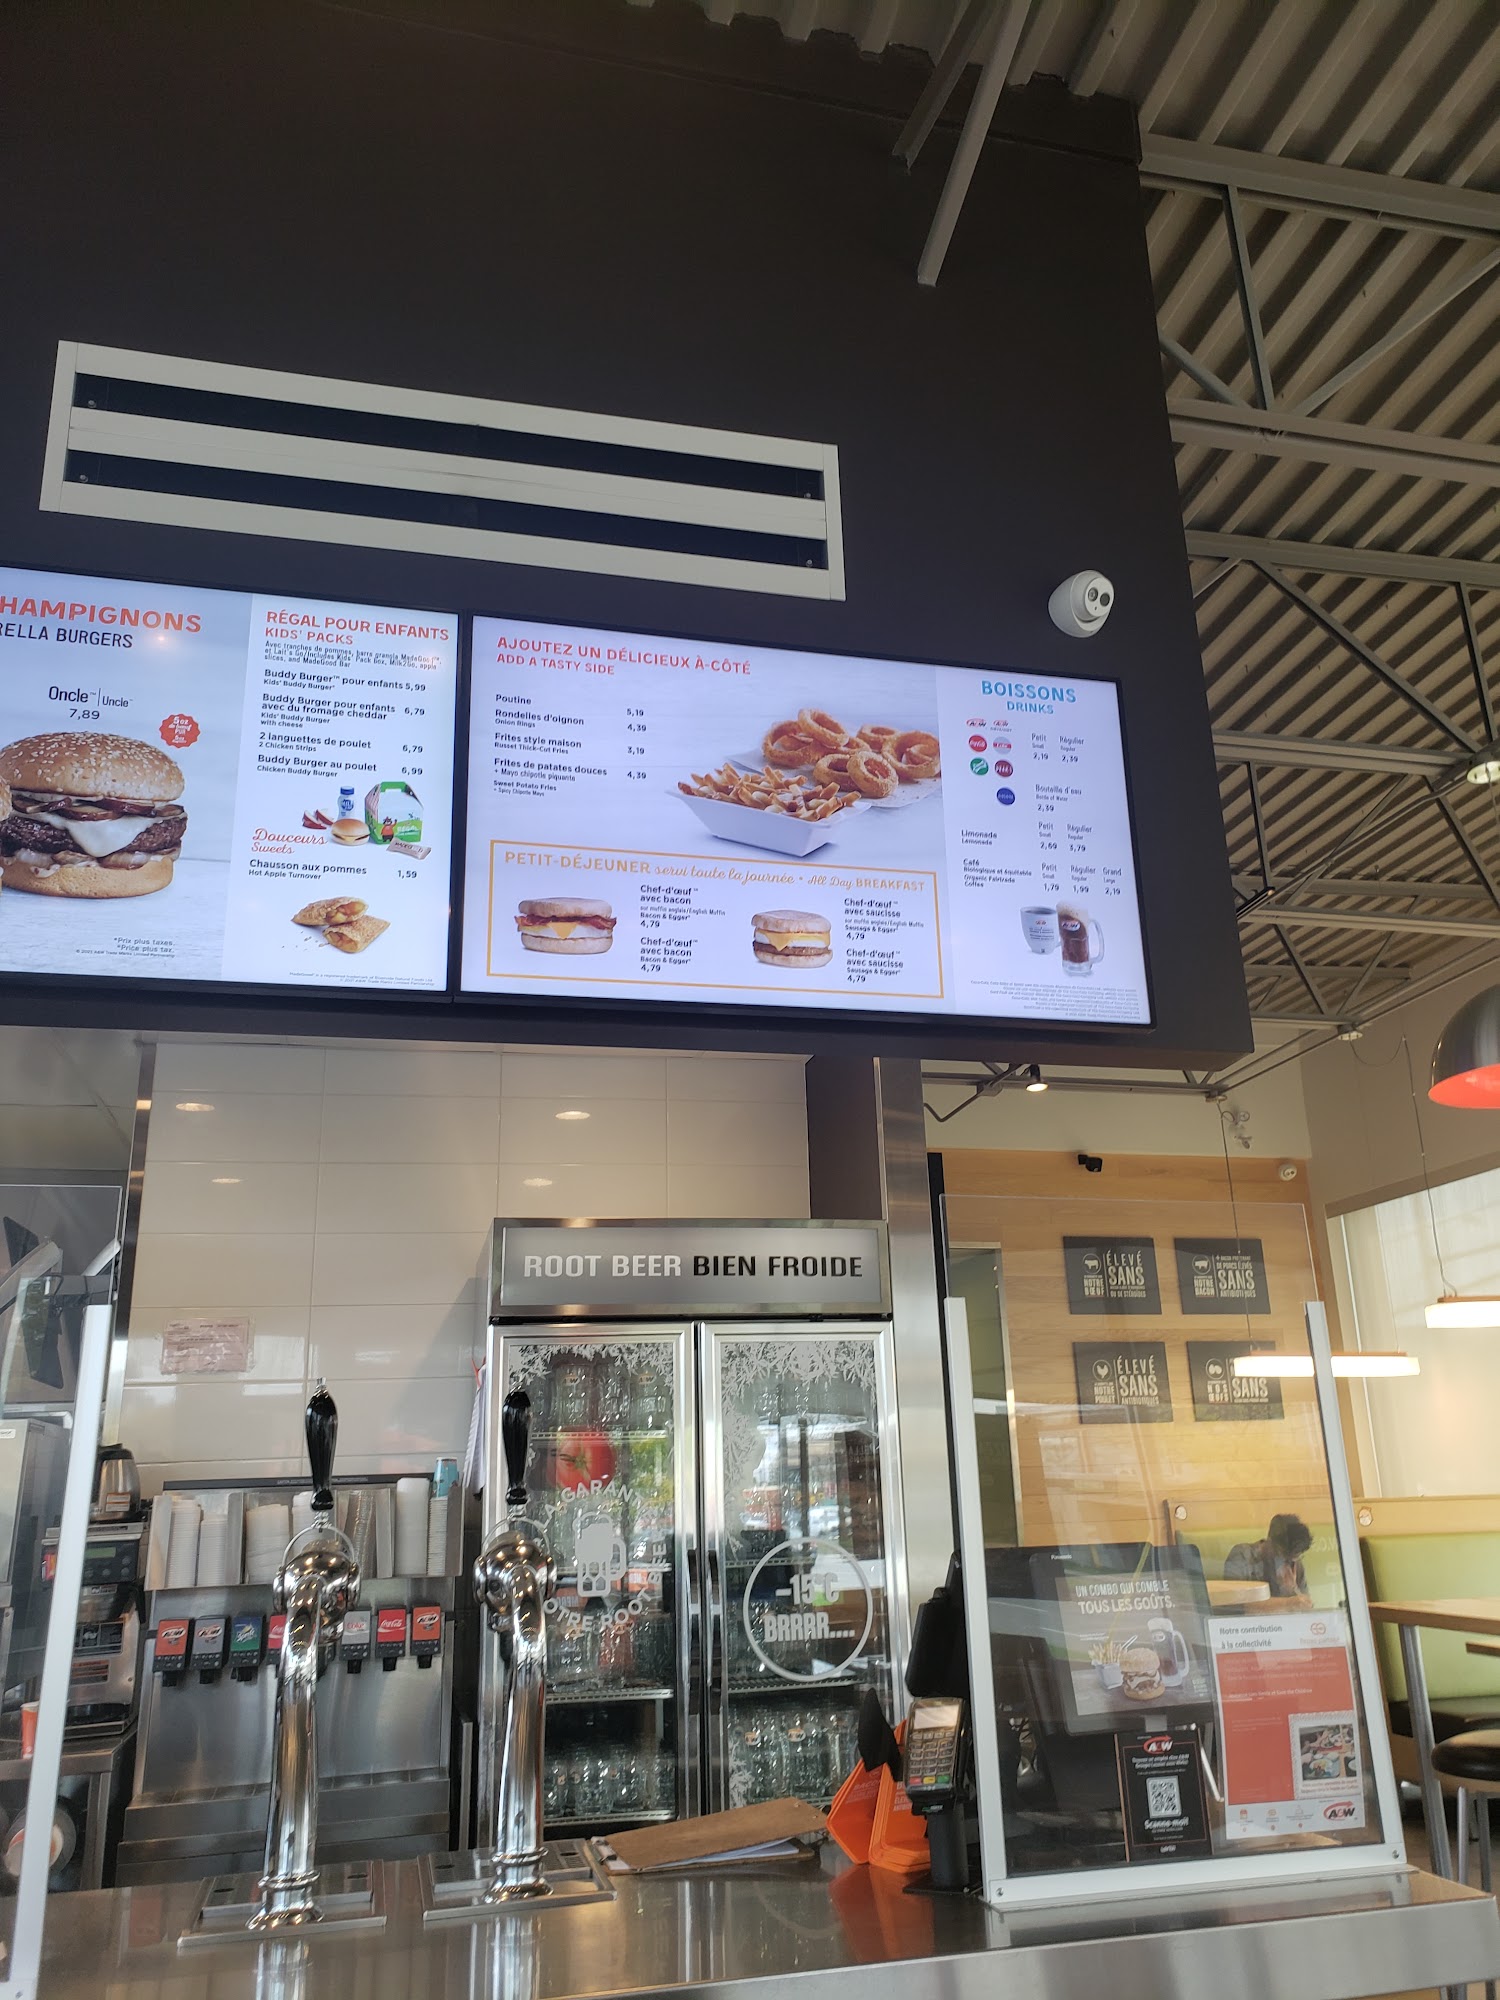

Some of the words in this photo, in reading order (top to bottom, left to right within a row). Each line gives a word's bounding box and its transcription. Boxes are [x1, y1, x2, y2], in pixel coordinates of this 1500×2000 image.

[267, 610, 320, 627] RÉGAL
[325, 617, 370, 632] POUR
[376, 622, 449, 641] ENFANTS
[56, 628, 133, 648] BURGERS
[265, 627, 302, 640] KIDS'
[307, 632, 353, 645] PACKS
[497, 636, 573, 656] AJOUTEZ
[578, 646, 601, 659] UN
[607, 647, 690, 669] DÉLICIEUX
[695, 655, 751, 675] À-CÔTÉ
[497, 653, 525, 665] ADD
[529, 657, 537, 666] A
[541, 658, 581, 671] TASTY
[585, 663, 615, 675] SIDE
[265, 669, 296, 680] Buddy
[343, 677, 364, 686] pour
[368, 679, 403, 690] enfants
[406, 683, 426, 692] 5,99
[496, 694, 532, 705] Poutine
[981, 680, 1076, 703] BOISSONS
[262, 703, 284, 711] avec
[287, 705, 300, 713] du
[303, 706, 345, 717] fromage
[347, 710, 387, 720] cheddar
[263, 693, 295, 704] Buddy
[298, 696, 331, 708] Burger
[334, 700, 357, 710] pour
[360, 702, 395, 713] enfants
[405, 707, 425, 716] 6,79
[627, 708, 644, 717] 5,19
[1007, 701, 1054, 714] DRINKS
[69, 709, 100, 720] 7,89
[495, 709, 541, 721] Rondelles
[544, 714, 584, 726] d'oignon
[627, 724, 646, 733] 4,39
[259, 732, 266, 740] 2
[268, 732, 321, 745] languettes
[325, 737, 336, 746] de
[340, 739, 371, 749] poulet
[403, 745, 423, 753] 6,79
[495, 733, 521, 742] Frites
[524, 735, 546, 745] style
[548, 738, 582, 748] maison
[627, 747, 645, 755] 3,19
[1033, 752, 1049, 760] 2,19
[257, 765, 286, 773] Chicken
[288, 767, 311, 776] Buddy
[313, 770, 338, 778] Burger
[258, 754, 290, 765] Buddy
[293, 757, 327, 769] Burger
[345, 762, 377, 772] poulet
[402, 767, 422, 775] 6,99
[494, 758, 521, 767] Frites
[523, 760, 534, 768] de
[538, 763, 572, 773] patates
[575, 765, 607, 775] douces
[627, 771, 646, 779] 4,39
[961, 829, 997, 839] Limonade
[1038, 821, 1054, 831] Petit
[252, 827, 328, 845] Douceurs
[252, 842, 295, 855] Sweets
[250, 859, 299, 871] Chausson
[302, 864, 320, 872] aux
[323, 865, 367, 875] pommes
[398, 870, 417, 879] 1,59
[289, 872, 321, 880] Turnover
[504, 850, 651, 875] PETIT-DÉJEUNER
[654, 864, 688, 877] servi
[691, 866, 726, 880] toute
[729, 867, 744, 881] la
[808, 875, 828, 885] All
[829, 876, 854, 891] Day
[856, 877, 926, 892] BREAKFAST
[1041, 863, 1057, 872] Petit
[1103, 867, 1122, 876] Grand
[1044, 883, 1059, 891] 1,79
[640, 895, 661, 903] avec
[664, 896, 691, 905] bacon
[640, 920, 660, 928] 4,79
[664, 948, 692, 957] bacon
[523, 1255, 602, 1277] ROOT
[611, 1255, 681, 1277] BEER
[693, 1255, 756, 1277] BIEN
[768, 1255, 863, 1277] FROIDE
[1106, 1250, 1142, 1266] ÉLEVÉ
[1084, 1279, 1104, 1287] NOTRE
[1108, 1266, 1144, 1285] SANS
[1194, 1278, 1213, 1288] NOTRE
[1218, 1270, 1255, 1290] SANS
[1195, 1288, 1215, 1296] BACON
[1117, 1355, 1155, 1375] ÉLEVÉ
[1094, 1386, 1114, 1395] NOTRE
[1119, 1375, 1158, 1397] SANS
[1207, 1384, 1228, 1393] NOS
[1232, 1378, 1268, 1398] SANS
[1095, 1395, 1115, 1404] POULET
[1076, 1585, 1088, 1597] UN
[1089, 1583, 1118, 1596] COMBO
[1120, 1582, 1134, 1594] QUI
[1135, 1580, 1169, 1592] COMBLE
[543, 1598, 594, 1632] OTRE
[602, 1587, 652, 1631] ROOT
[1078, 1600, 1109, 1614] TOUS
[1111, 1599, 1133, 1612] LES
[1134, 1594, 1176, 1611] GOÛTS.
[1241, 1625, 1282, 1634] contribution
[1227, 1640, 1233, 1649] la
[1235, 1639, 1272, 1648] collectivité
[1145, 1738, 1173, 1753] A&W
[1326, 1804, 1355, 1820] A&W
